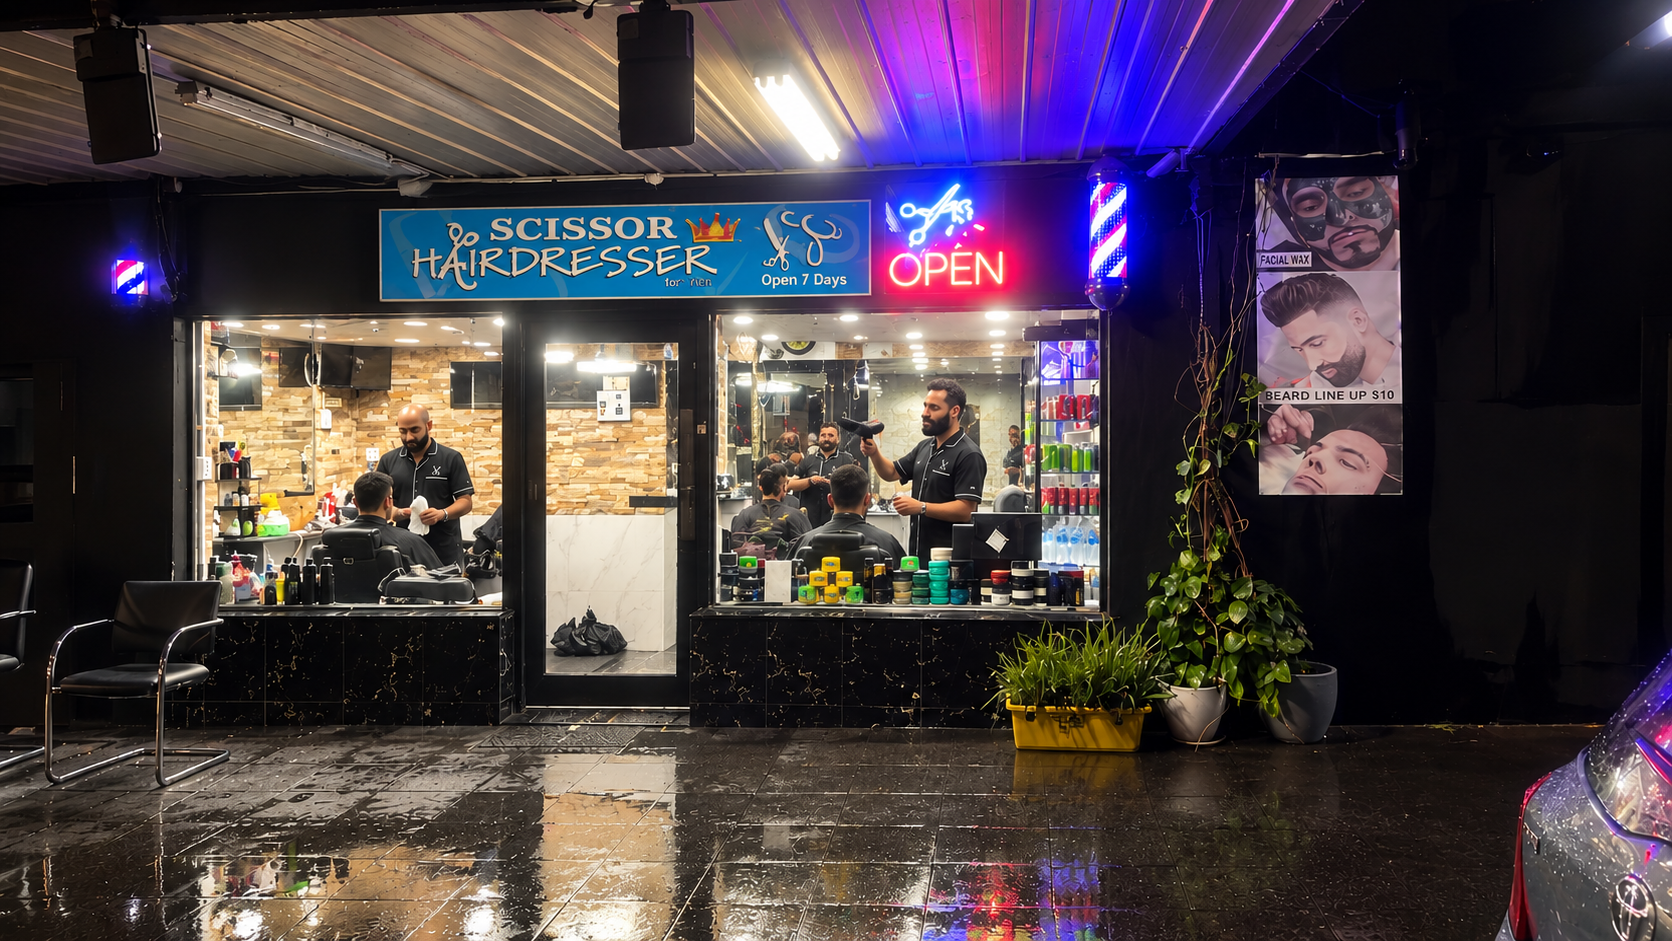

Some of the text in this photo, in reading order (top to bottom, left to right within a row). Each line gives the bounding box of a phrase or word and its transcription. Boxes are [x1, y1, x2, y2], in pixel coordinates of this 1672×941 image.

[489, 216, 677, 241] SCISSOR
[411, 222, 718, 291] HAIRDRESSER
[1260, 254, 1310, 266] FACIAL WAX
[889, 251, 1004, 287] OPEN
[665, 277, 685, 287] for
[761, 273, 847, 288] Open 7 Days
[1265, 391, 1310, 400] BEARD
[1315, 391, 1344, 400] LINE
[1349, 391, 1367, 400] UP
